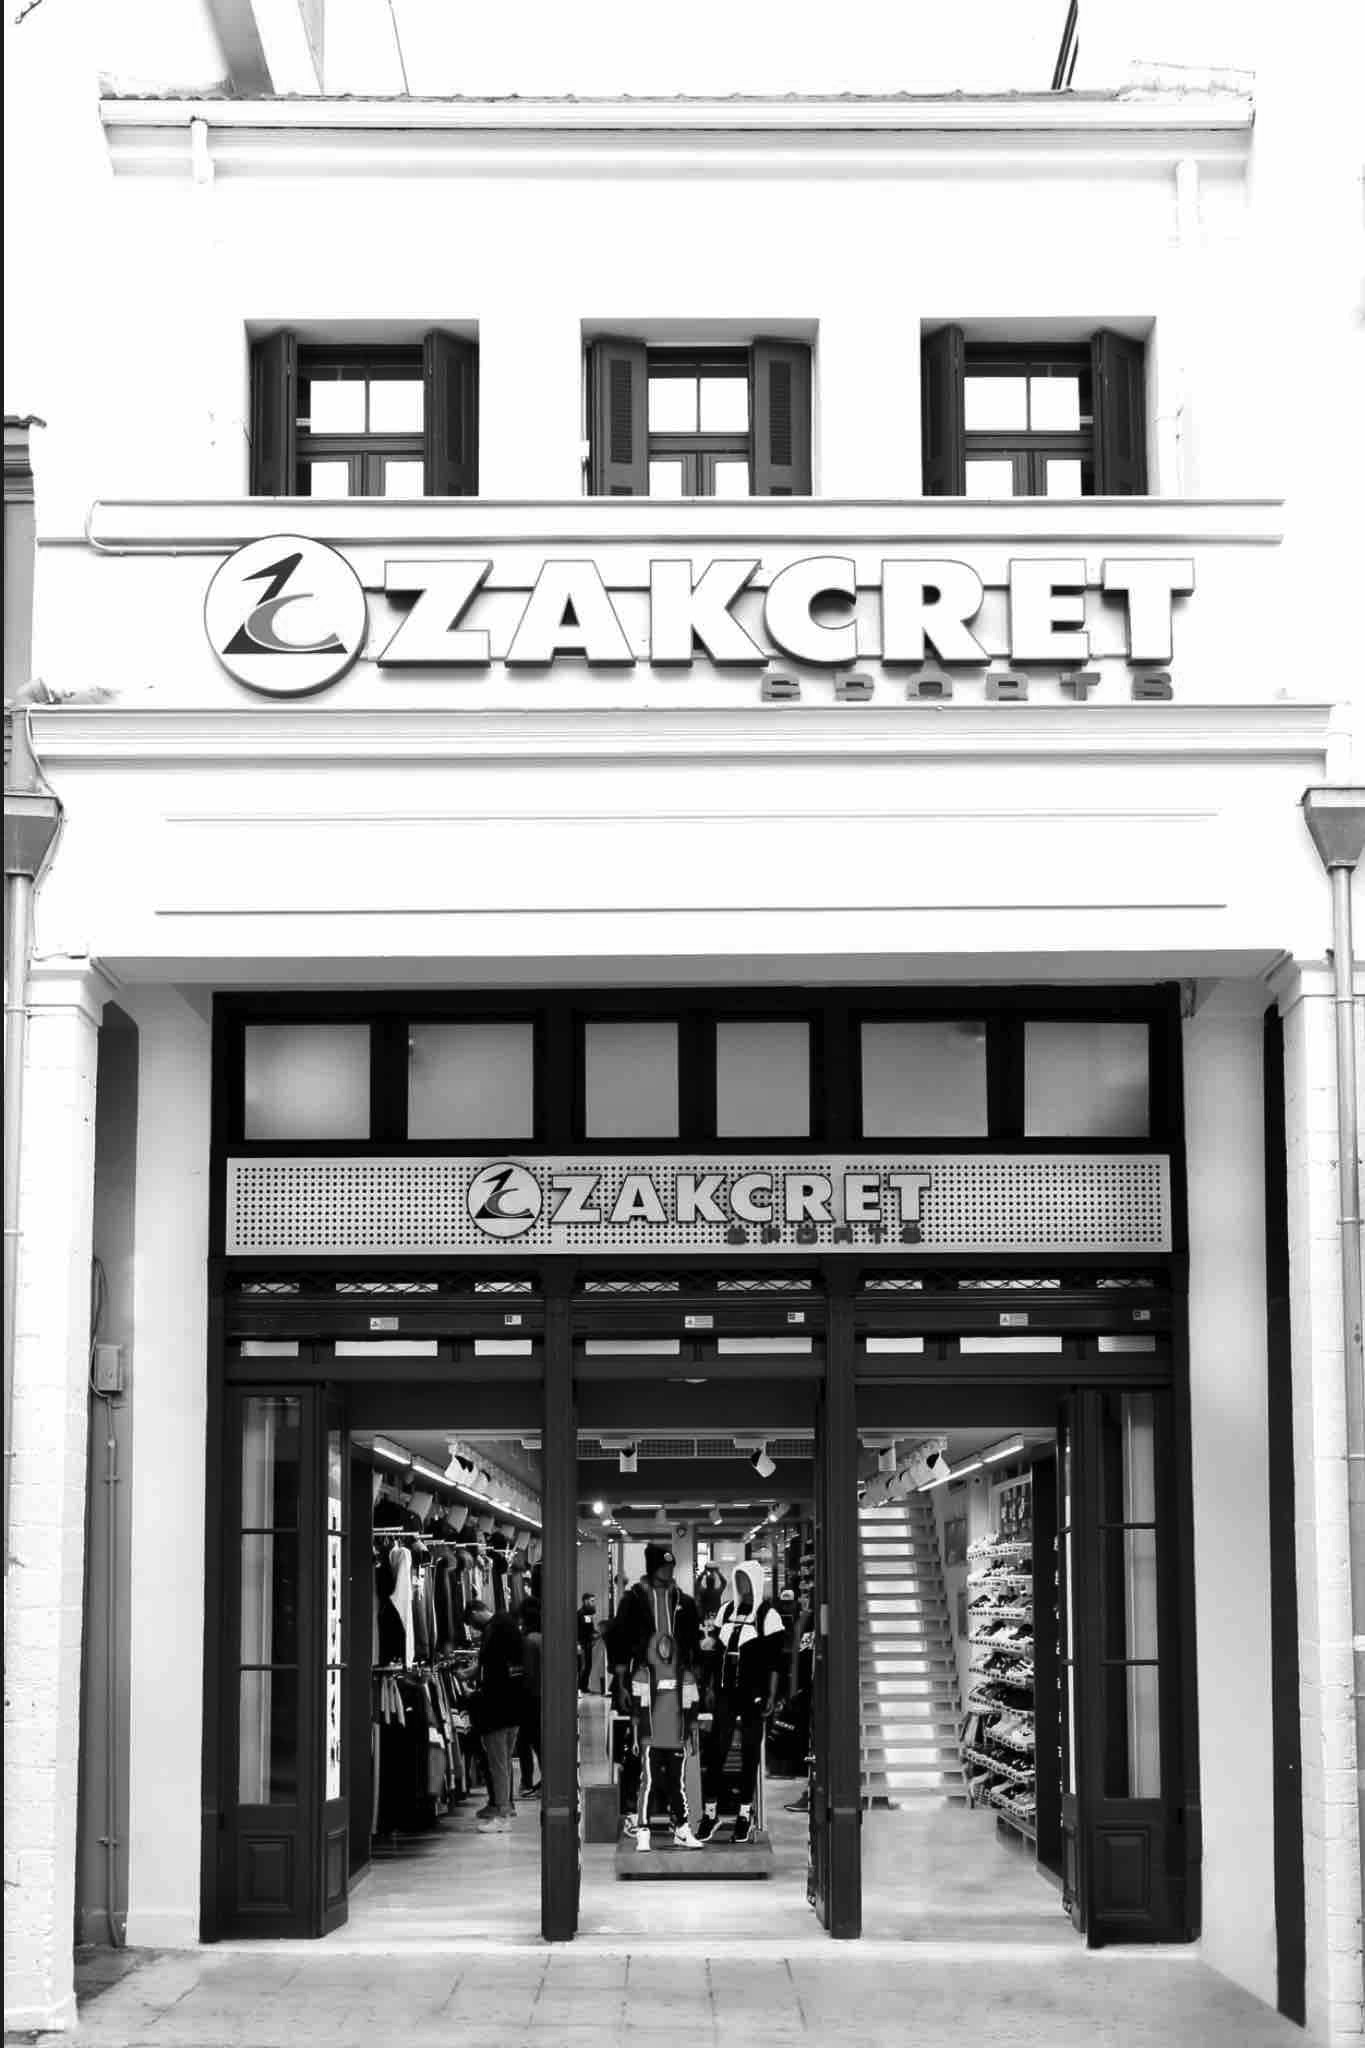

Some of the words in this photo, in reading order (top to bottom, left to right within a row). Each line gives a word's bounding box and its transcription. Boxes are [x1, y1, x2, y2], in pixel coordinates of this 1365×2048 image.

[377, 555, 1195, 669] ZAKCRET
[761, 672, 1174, 701] SPORTS
[550, 1172, 932, 1224] ZAKCRET
